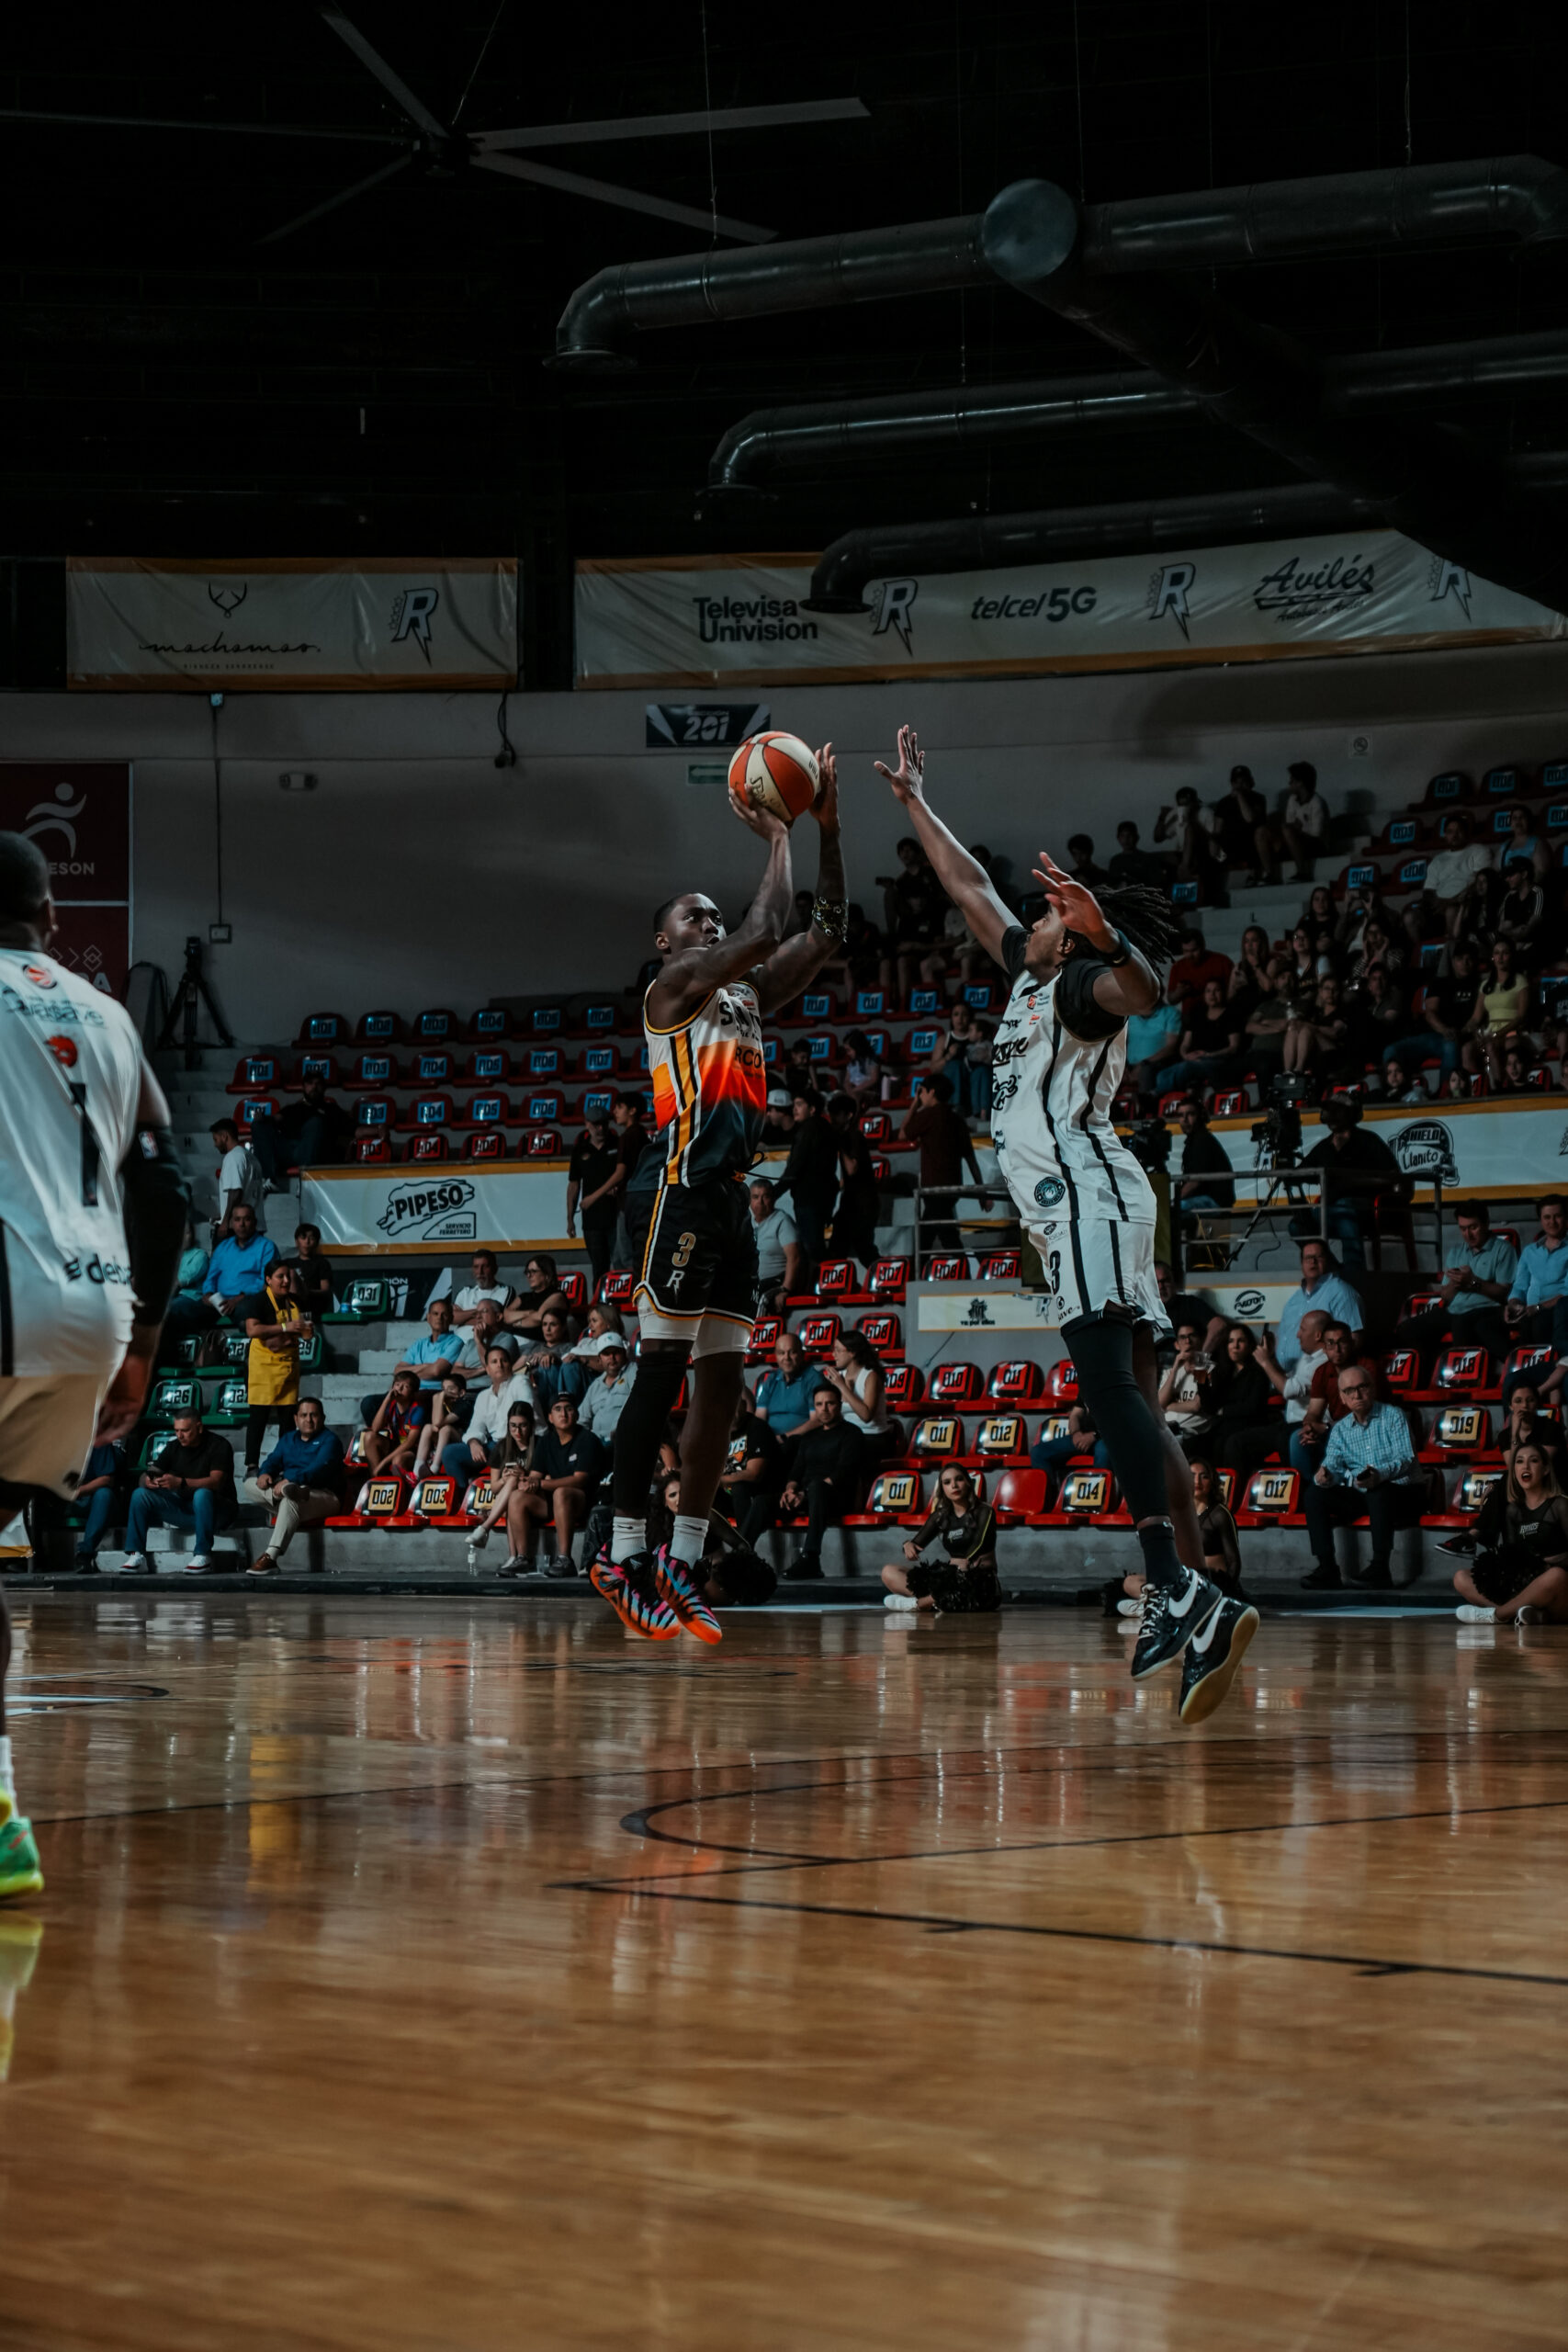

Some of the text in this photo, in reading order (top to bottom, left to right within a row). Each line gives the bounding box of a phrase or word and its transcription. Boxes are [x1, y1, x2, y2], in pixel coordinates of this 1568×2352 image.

[1253, 553, 1375, 596] Avilés
[693, 595, 797, 620] Televisa
[971, 585, 1098, 623] telcel 5G
[699, 619, 818, 643] Univision
[682, 714, 731, 741] 201
[423, 1060, 446, 1074] 004
[479, 1058, 500, 1072] 005
[533, 1055, 555, 1069] 006
[589, 1053, 610, 1067] 007
[1403, 1148, 1439, 1170] Llanito
[395, 1184, 463, 1221] PIPESO
[671, 1231, 697, 1269] 3
[822, 1268, 844, 1283] 006
[1049, 1250, 1061, 1296] 3
[358, 1287, 378, 1301] 031
[753, 1328, 774, 1342] 006
[809, 1324, 830, 1340] 007
[1453, 1356, 1475, 1374] 018
[943, 1372, 964, 1386] 010
[1004, 1368, 1021, 1385] 011
[990, 1425, 1011, 1442] 012
[1450, 1416, 1474, 1434] 019
[930, 1426, 948, 1442] 011
[372, 1488, 393, 1505] 002
[425, 1488, 446, 1504] 003
[479, 1488, 496, 1503] 00
[888, 1483, 907, 1499] 011
[1077, 1482, 1099, 1500] 014
[1265, 1480, 1289, 1498] 017
